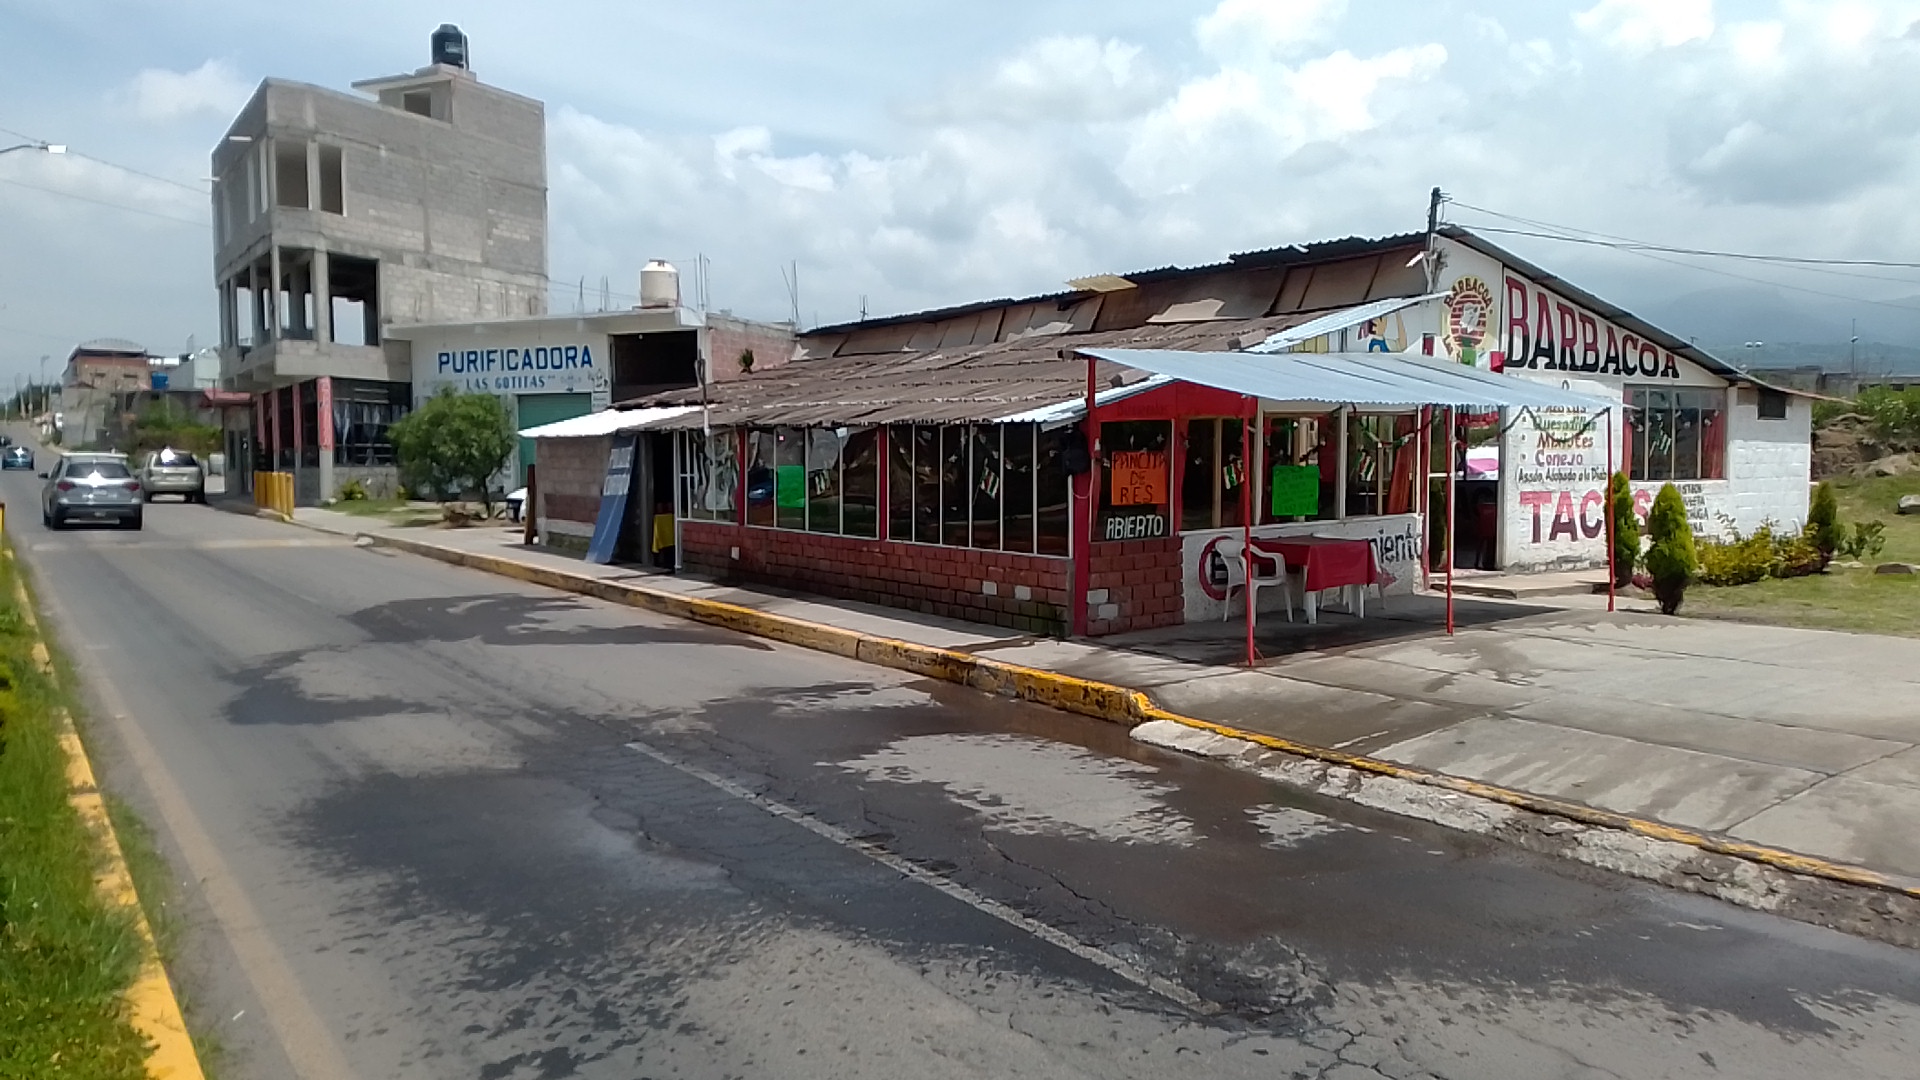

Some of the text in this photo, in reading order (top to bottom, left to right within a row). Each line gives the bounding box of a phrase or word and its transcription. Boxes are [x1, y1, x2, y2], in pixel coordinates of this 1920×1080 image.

[1443, 277, 1493, 309] BARBACOA
[1504, 275, 1680, 379] BARBACOA
[438, 344, 593, 374] PURIFICADORA
[466, 376, 488, 390] LAS
[495, 374, 546, 390] GOTITAS
[1535, 449, 1583, 467] Conejo
[1130, 470, 1147, 486] DE
[1120, 485, 1153, 504] RES
[1106, 514, 1163, 539] ABIERTO
[1520, 489, 1653, 543] TACS
